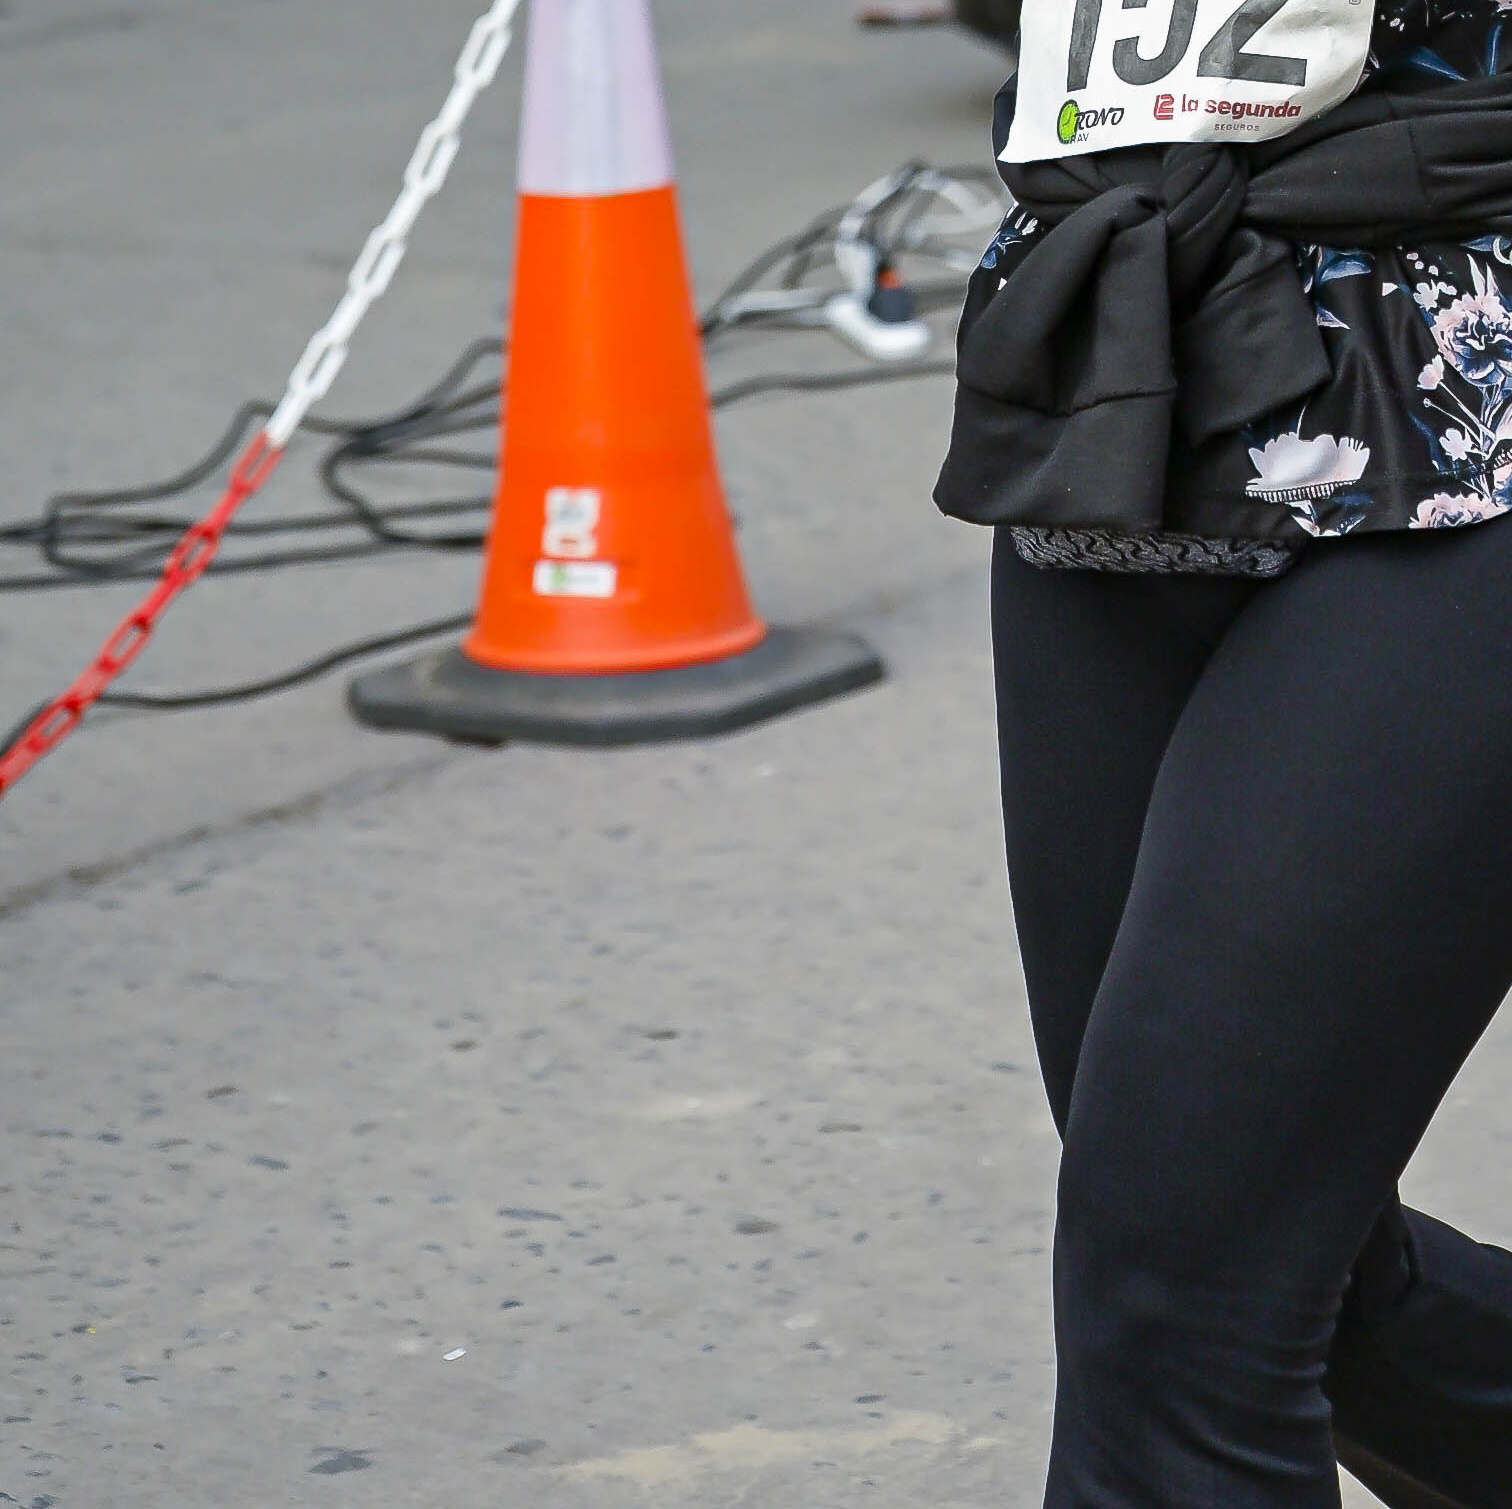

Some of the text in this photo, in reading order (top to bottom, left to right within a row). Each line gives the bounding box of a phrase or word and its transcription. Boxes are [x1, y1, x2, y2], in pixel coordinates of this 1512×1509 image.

[1181, 93, 1199, 112] la
[1204, 99, 1302, 120] segunda
[1213, 123, 1260, 132] SEGUROS
